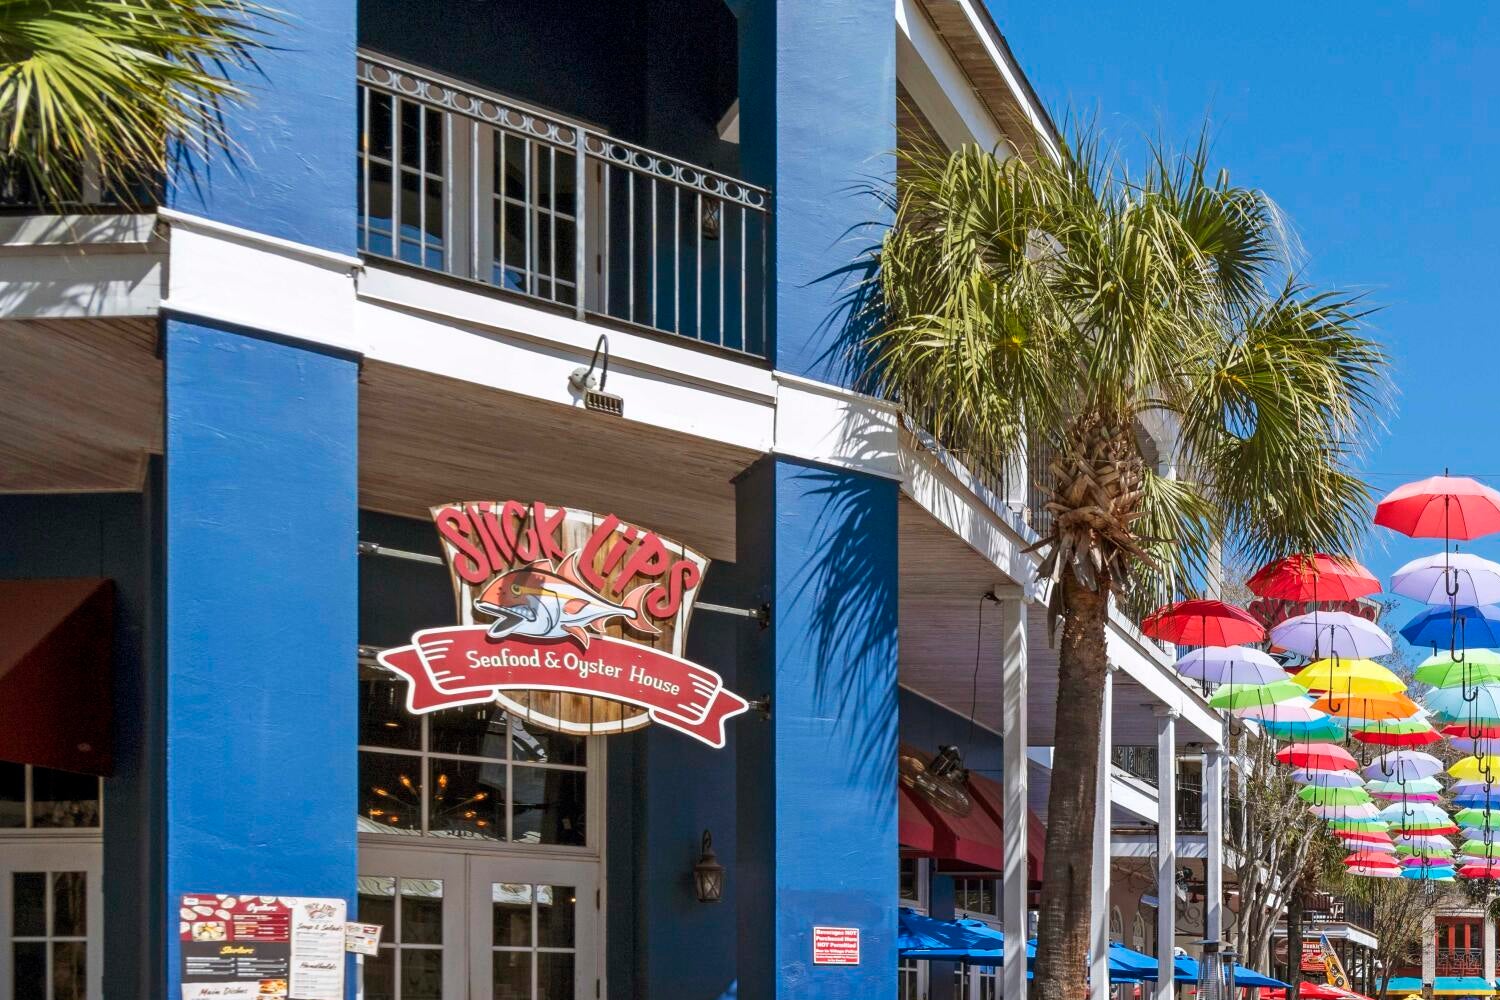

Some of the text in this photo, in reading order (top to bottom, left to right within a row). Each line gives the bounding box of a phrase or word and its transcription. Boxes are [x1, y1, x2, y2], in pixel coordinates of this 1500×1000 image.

[466, 648, 680, 696] Seafood & Oyster House
